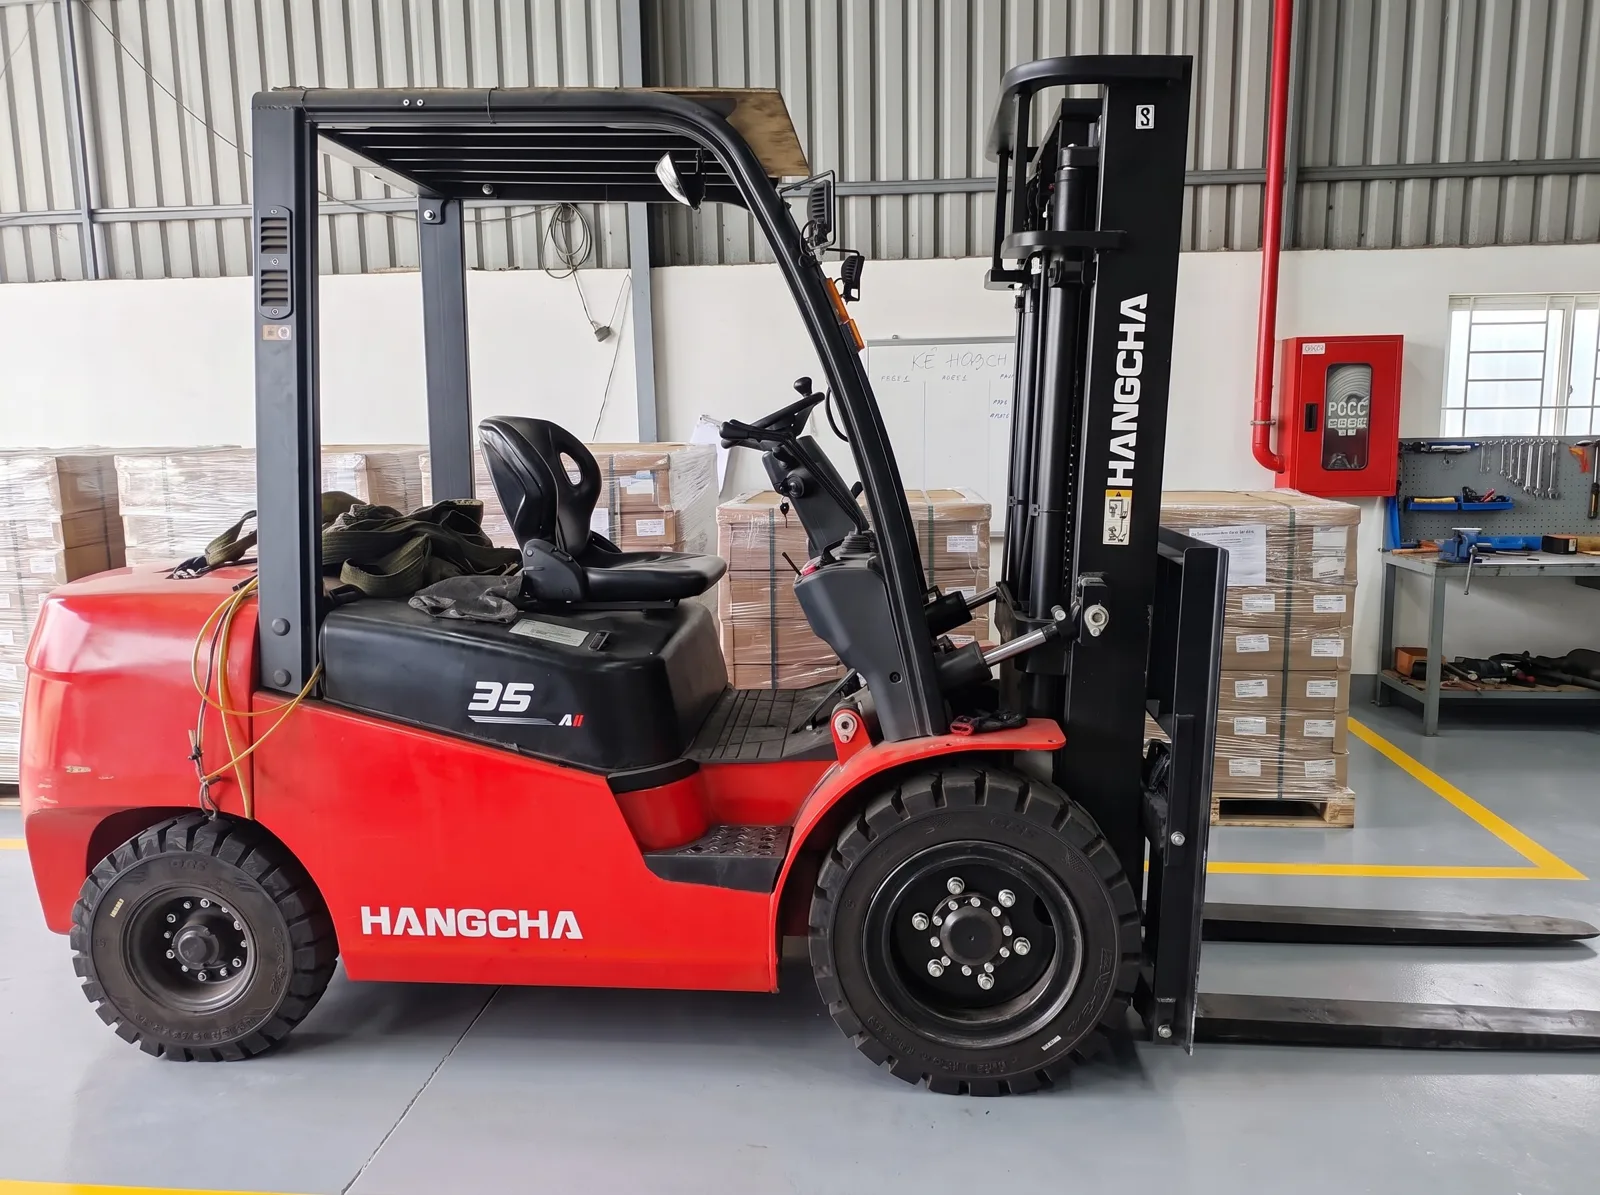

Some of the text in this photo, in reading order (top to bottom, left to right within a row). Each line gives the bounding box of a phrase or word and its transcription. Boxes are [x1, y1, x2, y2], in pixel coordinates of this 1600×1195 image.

[1107, 293, 1148, 487] HANGCHA
[467, 681, 535, 713] 35
[360, 905, 584, 940] HANGCHA
